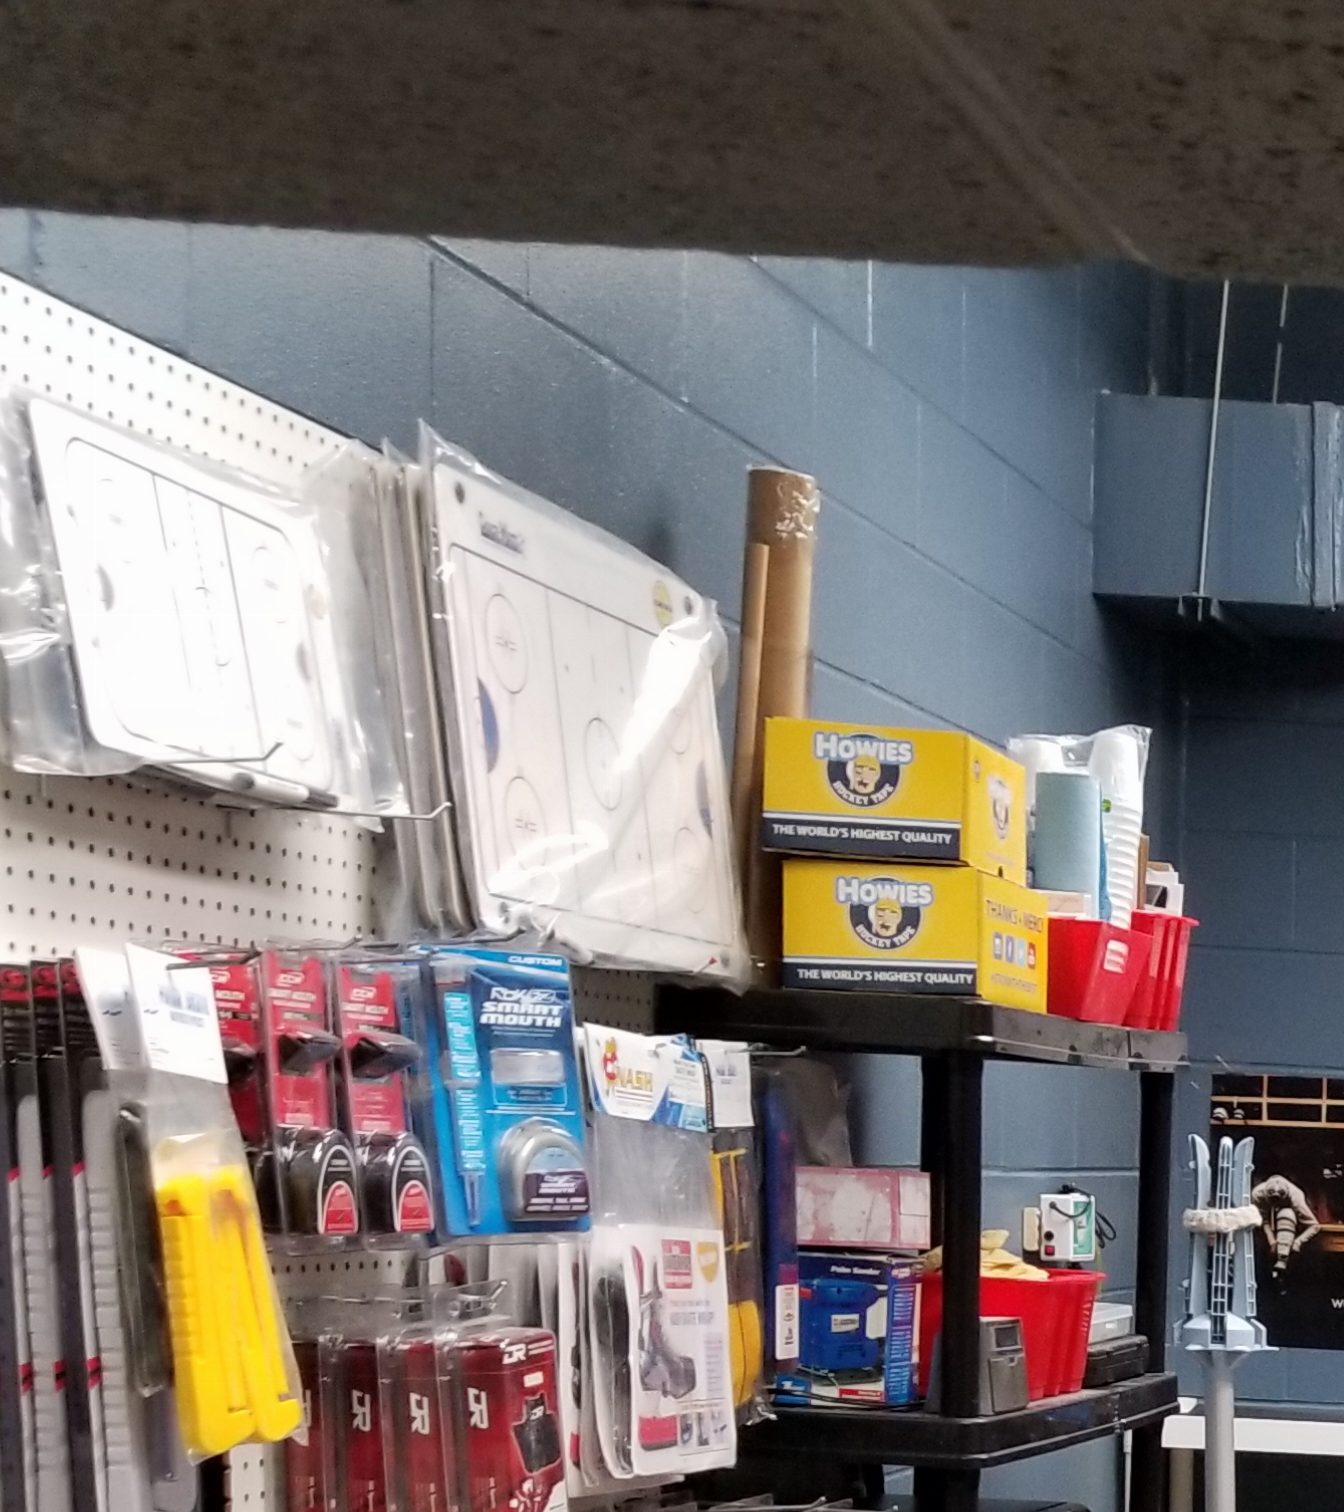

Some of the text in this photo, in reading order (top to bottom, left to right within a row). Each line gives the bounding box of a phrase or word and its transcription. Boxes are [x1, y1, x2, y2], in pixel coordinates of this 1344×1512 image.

[814, 731, 914, 763] HOWIES
[772, 824, 952, 845] THE WORLD'S HIGHEST QUALITY
[836, 876, 934, 905] HOWIES
[508, 956, 563, 966] CUSTOM
[797, 968, 974, 985] THE WORLD'S HIGHEST QUALITY
[481, 1001, 564, 1016] SMART
[480, 1013, 562, 1027] MOUTH
